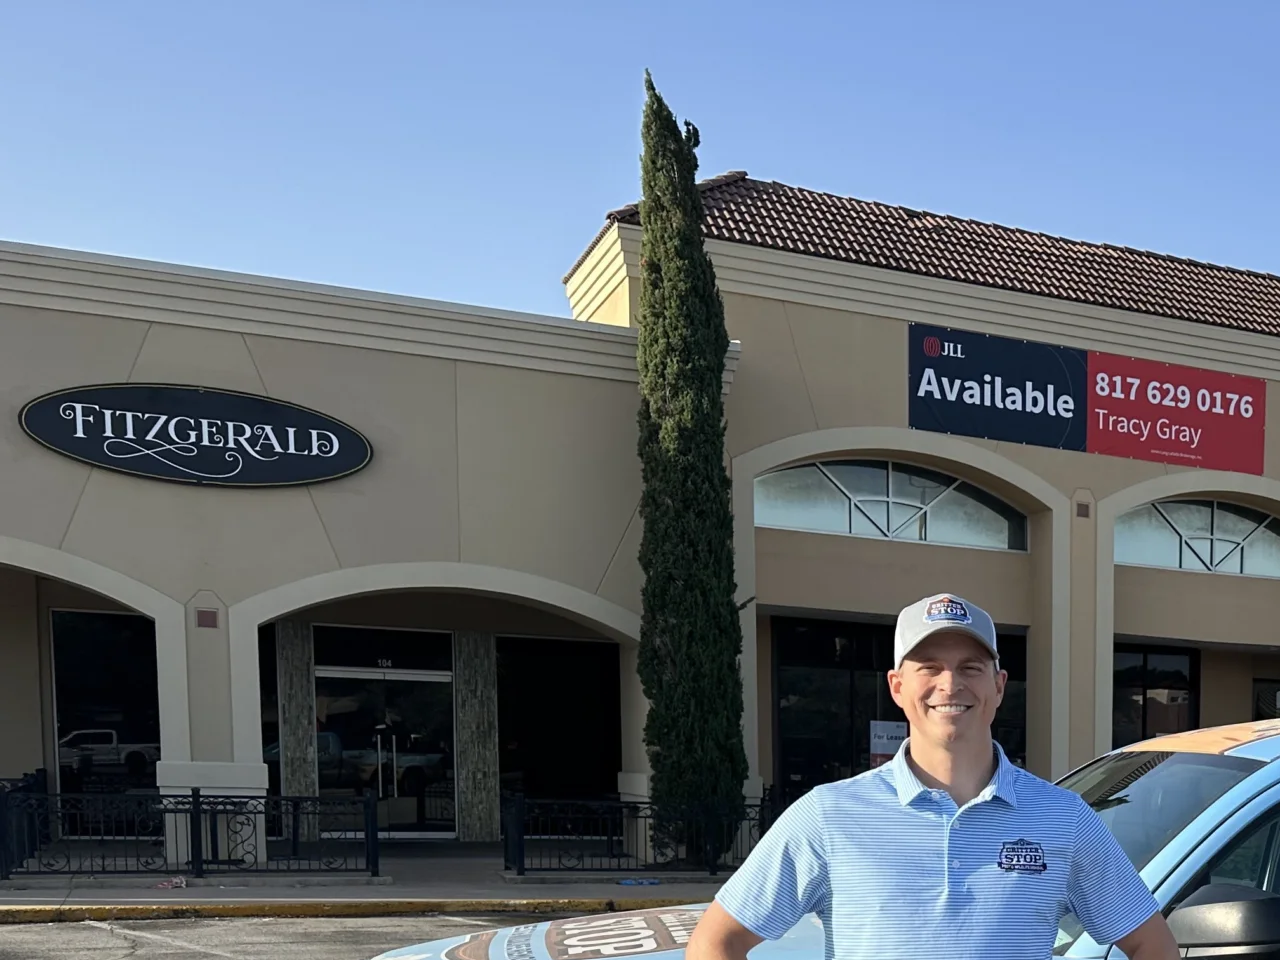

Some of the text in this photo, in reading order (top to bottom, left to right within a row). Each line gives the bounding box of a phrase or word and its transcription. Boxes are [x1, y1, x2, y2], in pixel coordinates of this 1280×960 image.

[941, 341, 966, 359] JLL
[917, 367, 1076, 419] Available
[1095, 371, 1254, 419] 817 629 0176
[1095, 408, 1203, 449] Tracy Gray
[60, 402, 340, 474] FITZGERALD
[930, 607, 965, 616] STOP
[377, 658, 392, 668] 104
[1005, 846, 1040, 854] CRITTER
[1005, 853, 1042, 864] STOP
